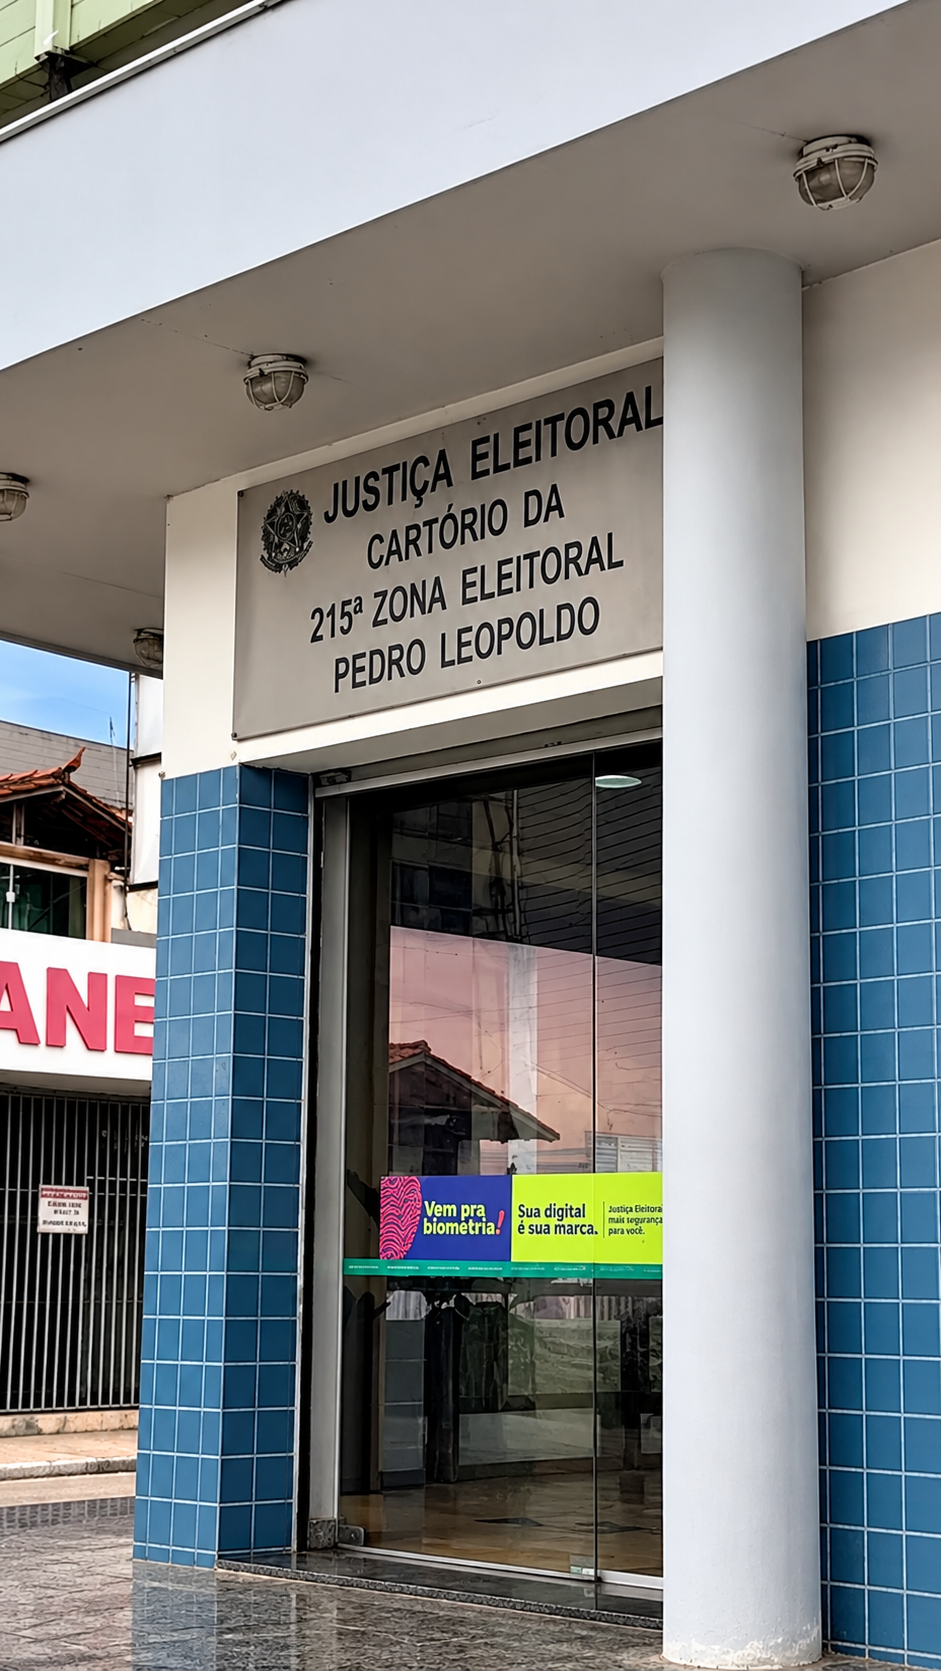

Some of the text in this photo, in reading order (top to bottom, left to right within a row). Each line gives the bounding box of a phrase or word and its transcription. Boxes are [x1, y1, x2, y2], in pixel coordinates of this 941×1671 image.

[323, 385, 663, 524] JUSTIÇA ELEITORAL
[367, 483, 565, 570] CARTÓRIO DA
[371, 575, 447, 629] ZONA
[461, 532, 625, 607] ELEITORAL
[334, 596, 600, 694] PEDRO LEOPOLDO
[424, 1200, 486, 1221] Vem pra
[518, 1203, 586, 1222] Sua digital
[634, 1203, 663, 1213] Eleitora
[423, 1210, 505, 1235] biometria!
[517, 1219, 599, 1235] é sua marca.
[608, 1227, 625, 1237] para
